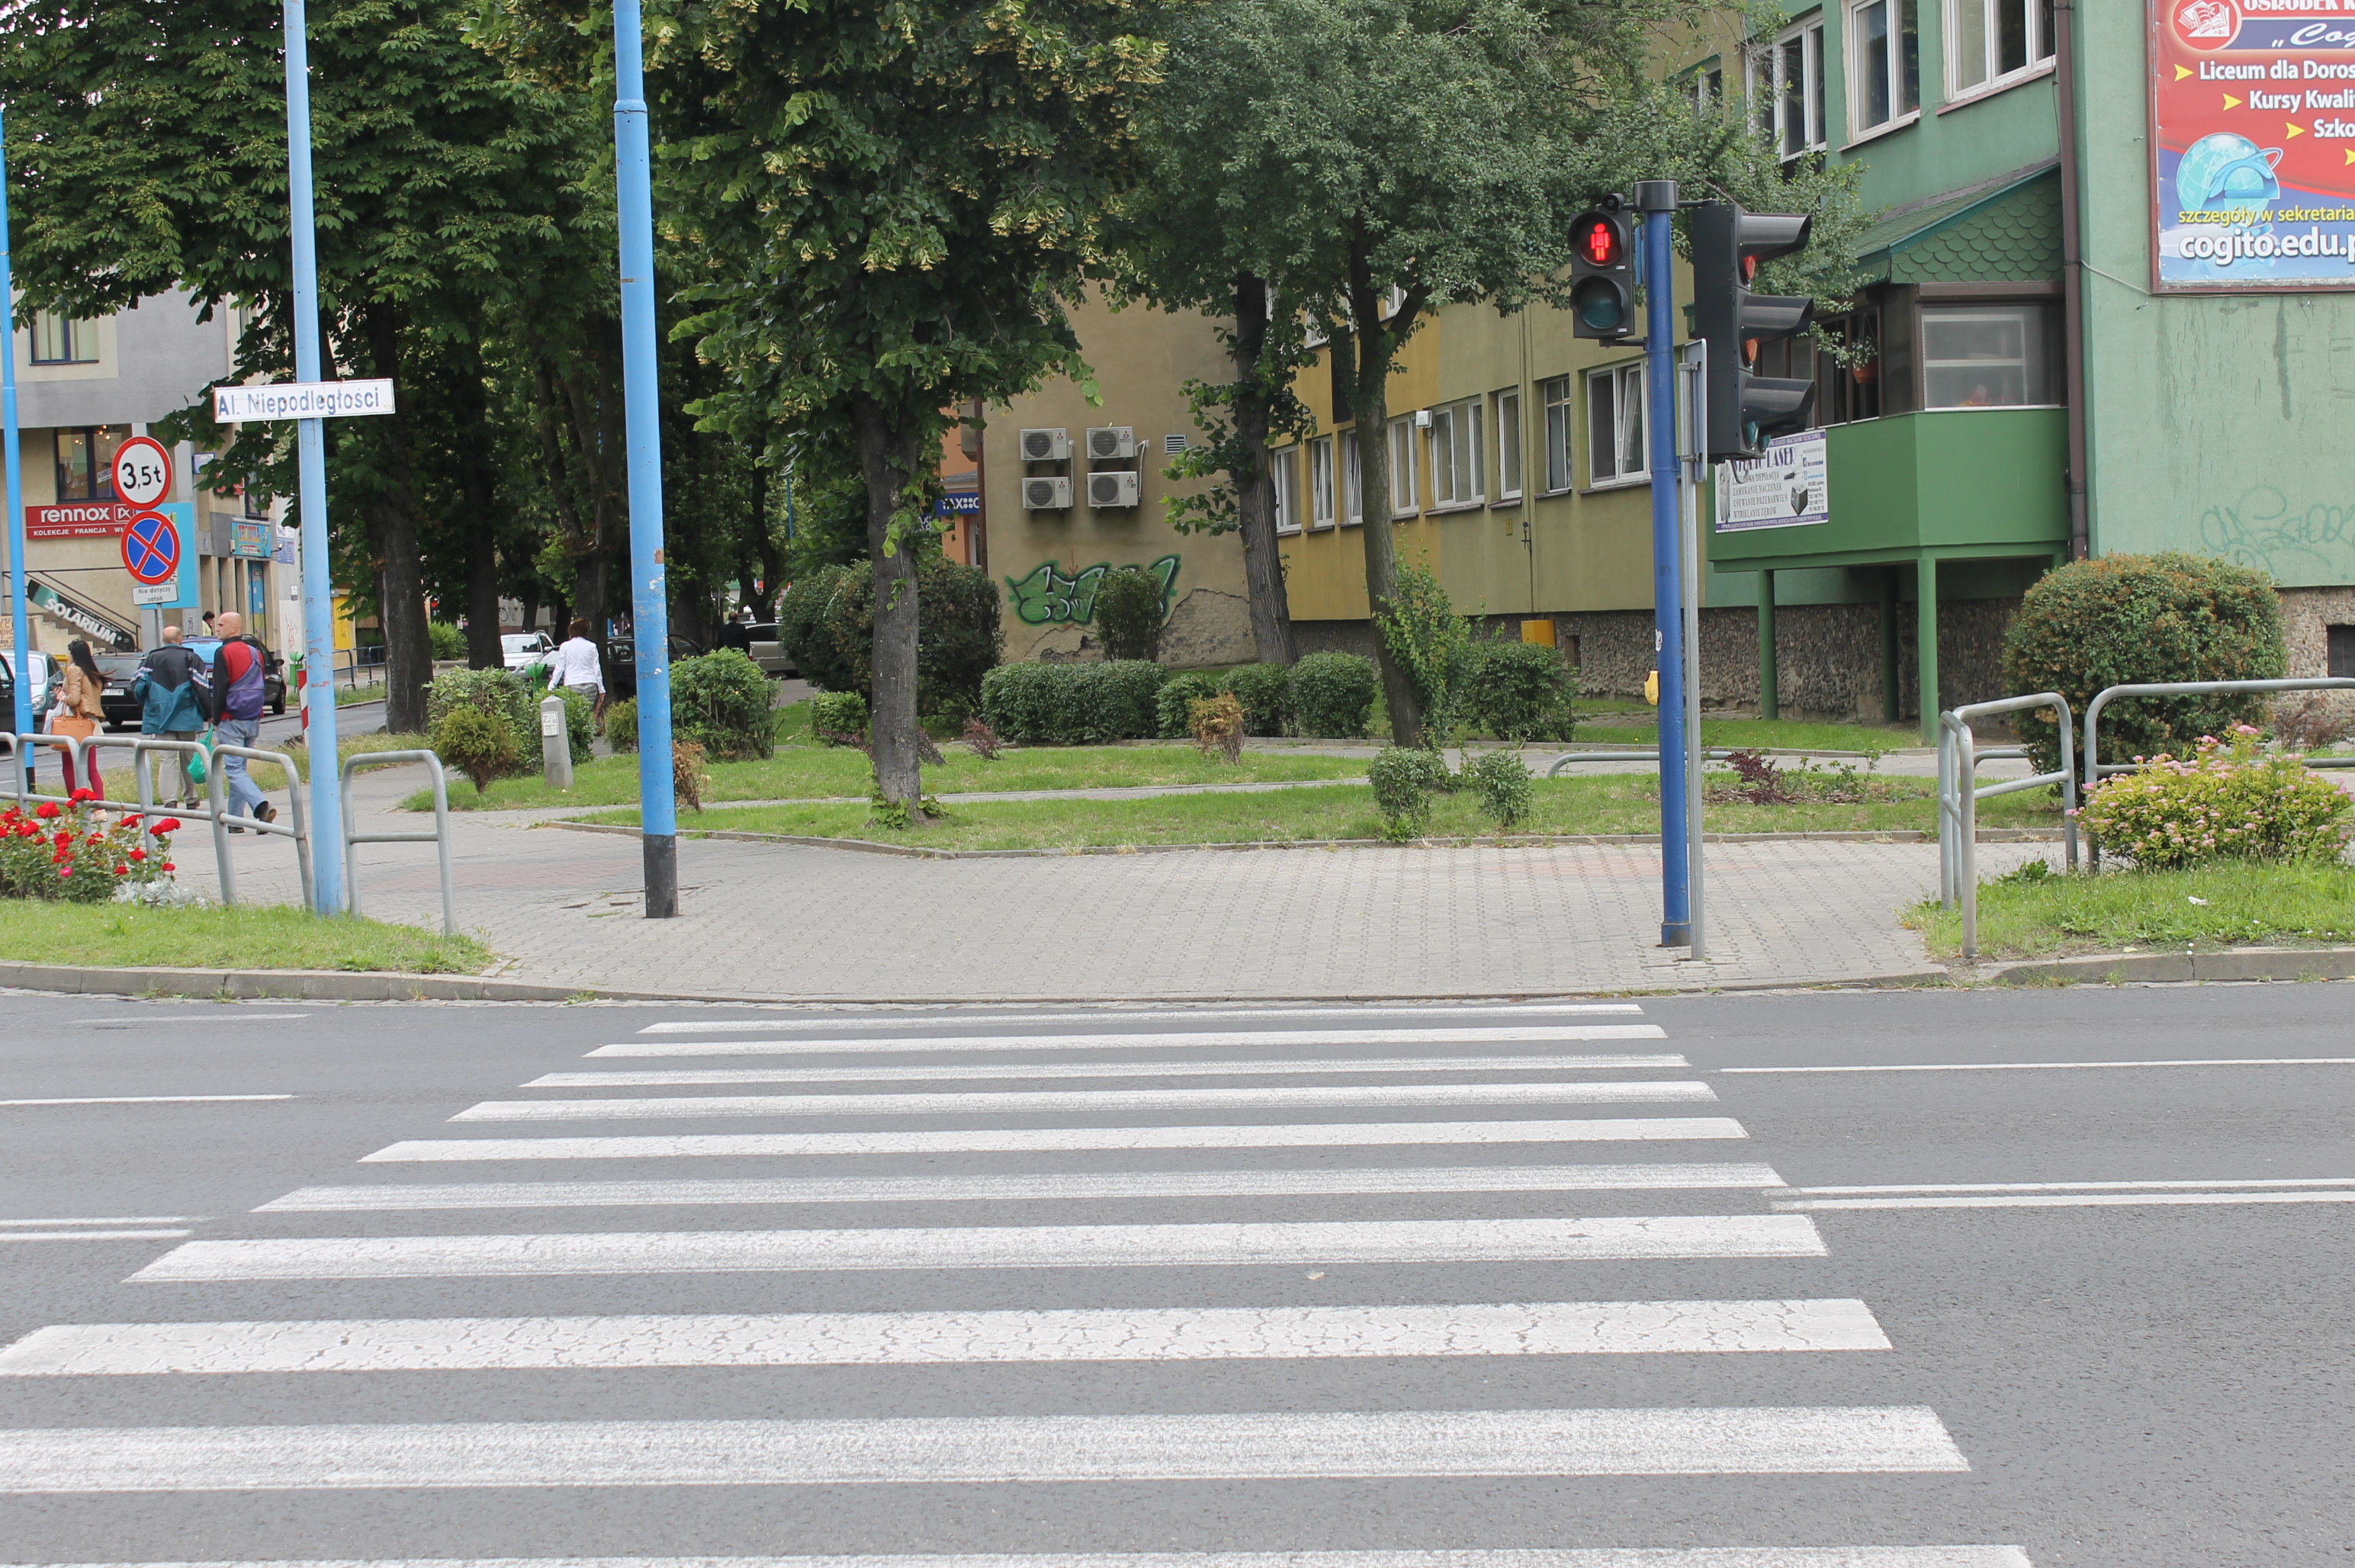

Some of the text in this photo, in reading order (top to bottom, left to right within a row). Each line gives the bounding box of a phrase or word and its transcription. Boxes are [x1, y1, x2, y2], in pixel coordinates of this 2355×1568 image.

[2199, 61, 2265, 80] Liceum
[2270, 59, 2299, 79] dla
[2249, 89, 2355, 114] Kursy Kwali
[2313, 117, 2355, 138] Szko
[2178, 206, 2256, 227] szczegóły
[2260, 210, 2274, 222] w
[218, 387, 380, 418] Al. Niepodległości
[1766, 447, 1796, 468] LASER
[1733, 496, 1756, 508] USUWANIE
[40, 507, 111, 524] rennox
[1733, 508, 1760, 519] WYBIELANIE
[149, 586, 171, 595] dotyczy
[44, 598, 117, 645] SOLARIUM
